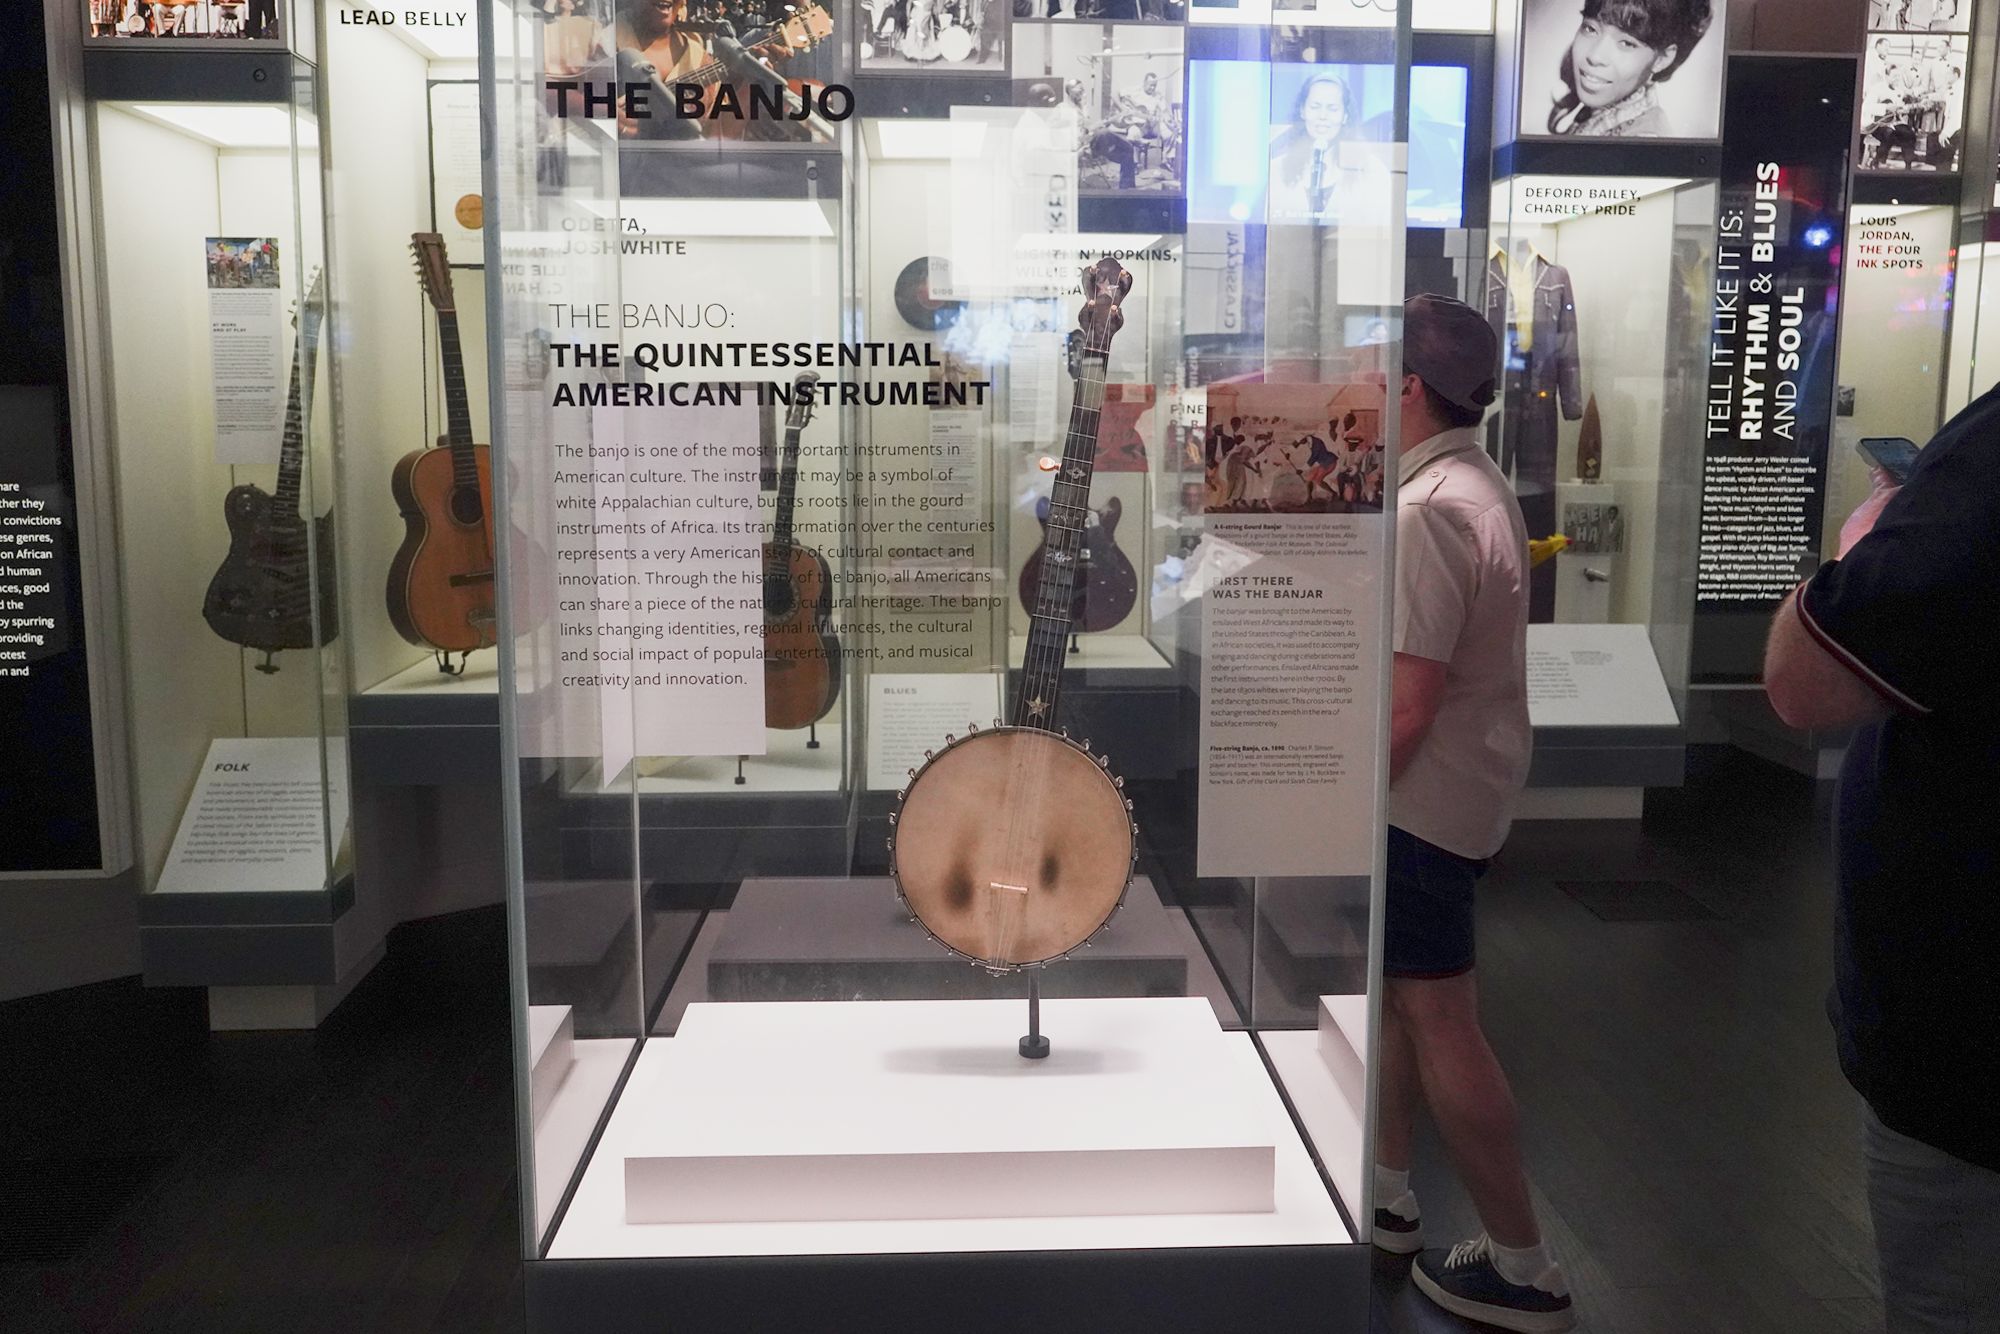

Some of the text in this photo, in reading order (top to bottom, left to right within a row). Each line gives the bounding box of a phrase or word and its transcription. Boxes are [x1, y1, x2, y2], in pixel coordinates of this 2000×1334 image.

[341, 10, 467, 26] LEAD BELLY
[546, 81, 856, 122] THE BANJO
[1525, 187, 1641, 202] DEFORD BAILEY,
[1524, 203, 1636, 216] CHARLEY PRIDE
[562, 216, 648, 235] ODETTA,
[1860, 215, 1897, 226] LOUIS
[1859, 230, 1915, 242] JORDAN,
[562, 240, 618, 255] JOSH
[621, 240, 687, 255] WHITE
[1859, 245, 1921, 255] THE FOUR
[1101, 249, 1177, 263] HOPKINS,
[1857, 259, 1924, 269] INK SPOTS
[1740, 161, 1780, 440] RHYTHM & BLUES
[548, 302, 735, 329] THE BANJO:
[1707, 209, 1744, 439] TELL IT LIKE IT IS:
[550, 342, 941, 373] THE QUINTESSENTIAL
[1773, 287, 1805, 441] AND SOUL
[552, 381, 990, 408] AMERICAN INSTRUMENT
[555, 442, 960, 460] The banjo is one of the most important instruments in
[554, 468, 953, 485] American culture. The instrument may be a symbol of
[22, 498, 45, 511] they
[556, 496, 596, 509] white
[602, 495, 691, 512] Appalachian
[696, 496, 753, 510] culture,
[809, 498, 848, 507] roots
[853, 494, 869, 507] lie
[874, 495, 886, 507] in
[892, 494, 915, 507] the
[920, 494, 963, 511] gourd
[3, 515, 62, 526] convictions
[557, 522, 646, 535] instruments
[651, 520, 666, 534] of
[671, 520, 718, 534] Africa.
[722, 521, 739, 534] Its
[861, 522, 894, 533] over
[899, 520, 922, 533] the
[927, 520, 995, 533] centuries
[16, 534, 54, 545] genres,
[16, 548, 53, 559] African
[557, 548, 637, 563] represents
[641, 551, 649, 559] a
[654, 550, 685, 563] very
[690, 547, 760, 559] American
[808, 545, 822, 558] of
[828, 545, 883, 558] cultural
[888, 546, 942, 558] contact
[947, 544, 974, 558] and
[7, 565, 42, 576] human
[558, 570, 991, 589] innovation. Through the hisry of the banjo, all Americans
[1252, 576, 1294, 586] THERE
[23, 582, 50, 596] good
[1213, 589, 1323, 599] WAS THE BANJAR
[6, 600, 24, 610] the
[559, 595, 1001, 613] can share a piece of the nats cultural heritage. The banjo
[11, 615, 55, 629] spurring
[560, 620, 973, 639] links changing identities, regional influences, the cultural
[561, 648, 587, 661] and
[593, 648, 634, 661] social
[639, 647, 689, 664] impact
[694, 647, 709, 660] of
[713, 646, 769, 663] popular
[888, 645, 914, 658] and
[919, 644, 973, 658] musical
[10, 665, 30, 676] and
[562, 673, 747, 689] creativity and innovation.
[884, 687, 918, 695] BLUES
[214, 763, 250, 772] FOLK
